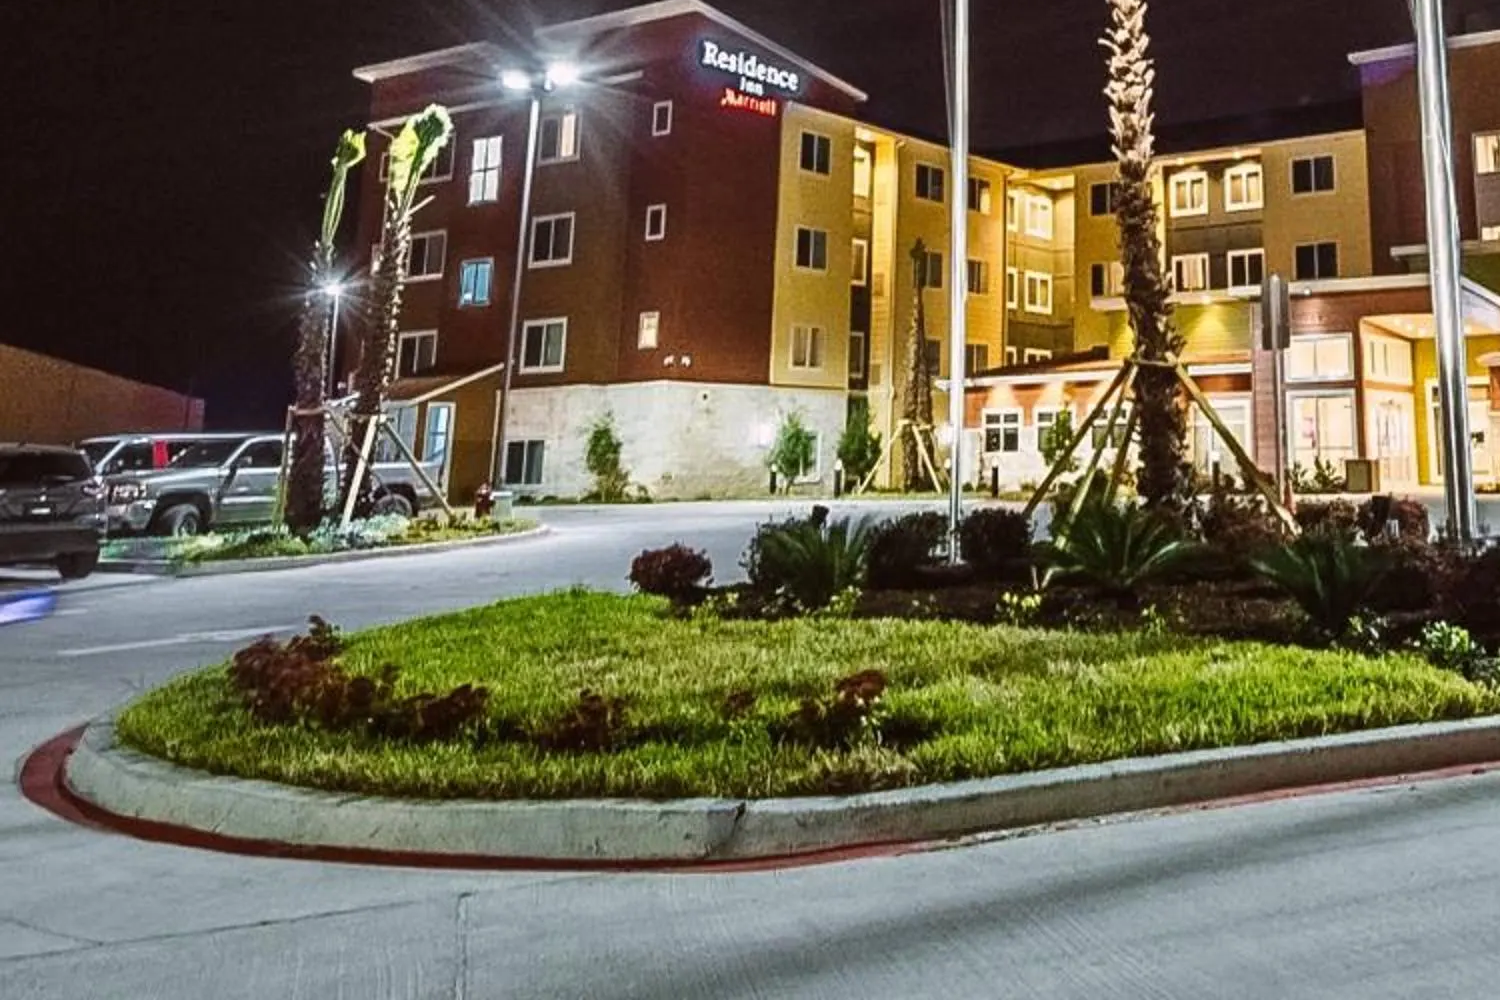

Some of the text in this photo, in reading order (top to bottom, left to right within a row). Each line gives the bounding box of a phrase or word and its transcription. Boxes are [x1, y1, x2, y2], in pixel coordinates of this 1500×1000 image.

[703, 41, 798, 90] Residence
[740, 77, 763, 96] Inn
[721, 89, 777, 116] Marriott
